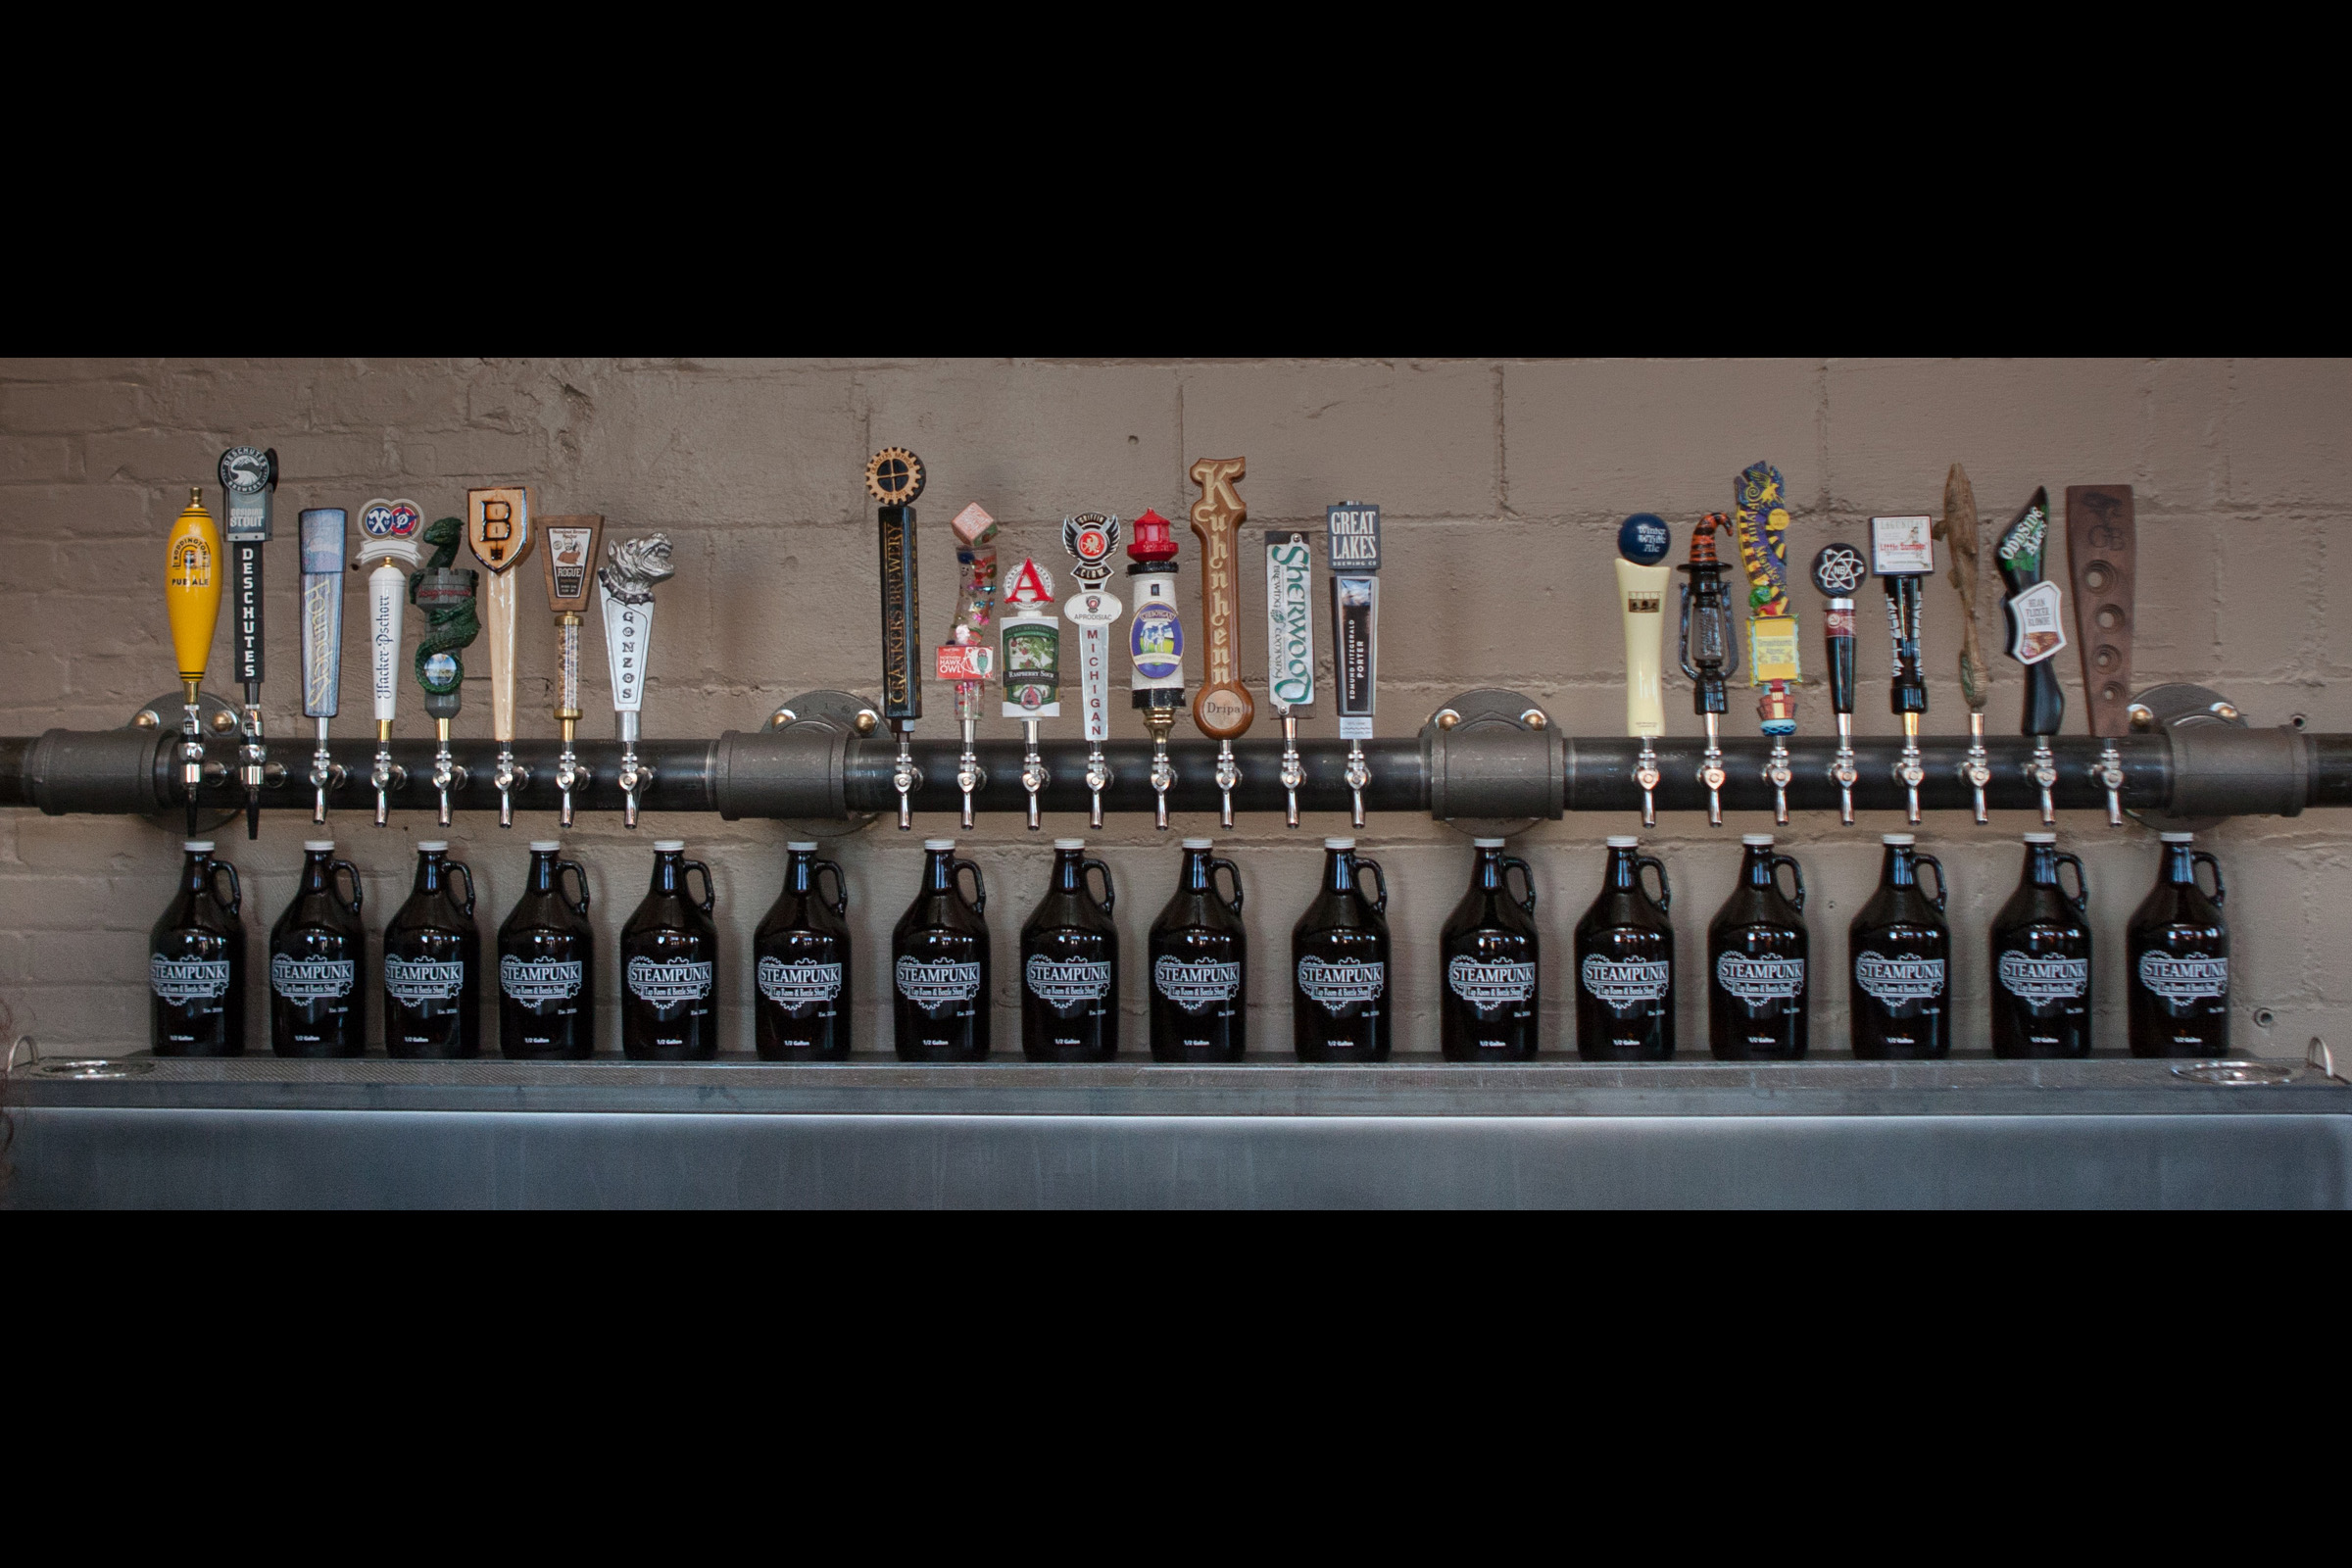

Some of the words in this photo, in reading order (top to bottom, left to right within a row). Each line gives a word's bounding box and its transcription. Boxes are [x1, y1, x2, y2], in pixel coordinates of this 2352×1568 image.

[223, 447, 268, 466] DESCHUTES
[229, 515, 265, 527] STOUT
[479, 500, 512, 542] B
[1079, 514, 1104, 523] GRIFFIN
[1331, 512, 1376, 535] GREAT
[1333, 535, 1377, 559] LAKES
[887, 522, 904, 608] BREWERY
[1080, 568, 1105, 578] CLAW
[1004, 558, 1054, 604] A
[242, 547, 256, 677] DESCHUTES
[622, 612, 635, 700] GONZOS
[940, 665, 962, 674] OWL
[1087, 629, 1102, 736] MICHIGAN
[1205, 701, 1241, 715] Dripa
[150, 966, 225, 979] STEAMPUNK
[274, 965, 350, 979] STEAMPUNK
[386, 966, 459, 980] STEAMPUNK
[503, 966, 578, 980] STEAMPUNK
[631, 967, 709, 981] STEAMPUNK
[761, 968, 838, 982] STEAMPUNK
[900, 967, 977, 981] STEAMPUNK
[1030, 966, 1107, 980] STEAMPUNK
[1159, 967, 1237, 981] STEAMPUNK
[1302, 967, 1381, 982] STEAMPUNK
[1453, 967, 1533, 982] STEAMPUNK
[1588, 966, 1666, 980] STEAMPUNK
[1722, 963, 1802, 978] STEAMPUNK
[1862, 963, 1941, 978] STEAMPUNK
[2004, 963, 2085, 977] STEAMPUNK
[2144, 963, 2227, 977] STEAMPUNK
